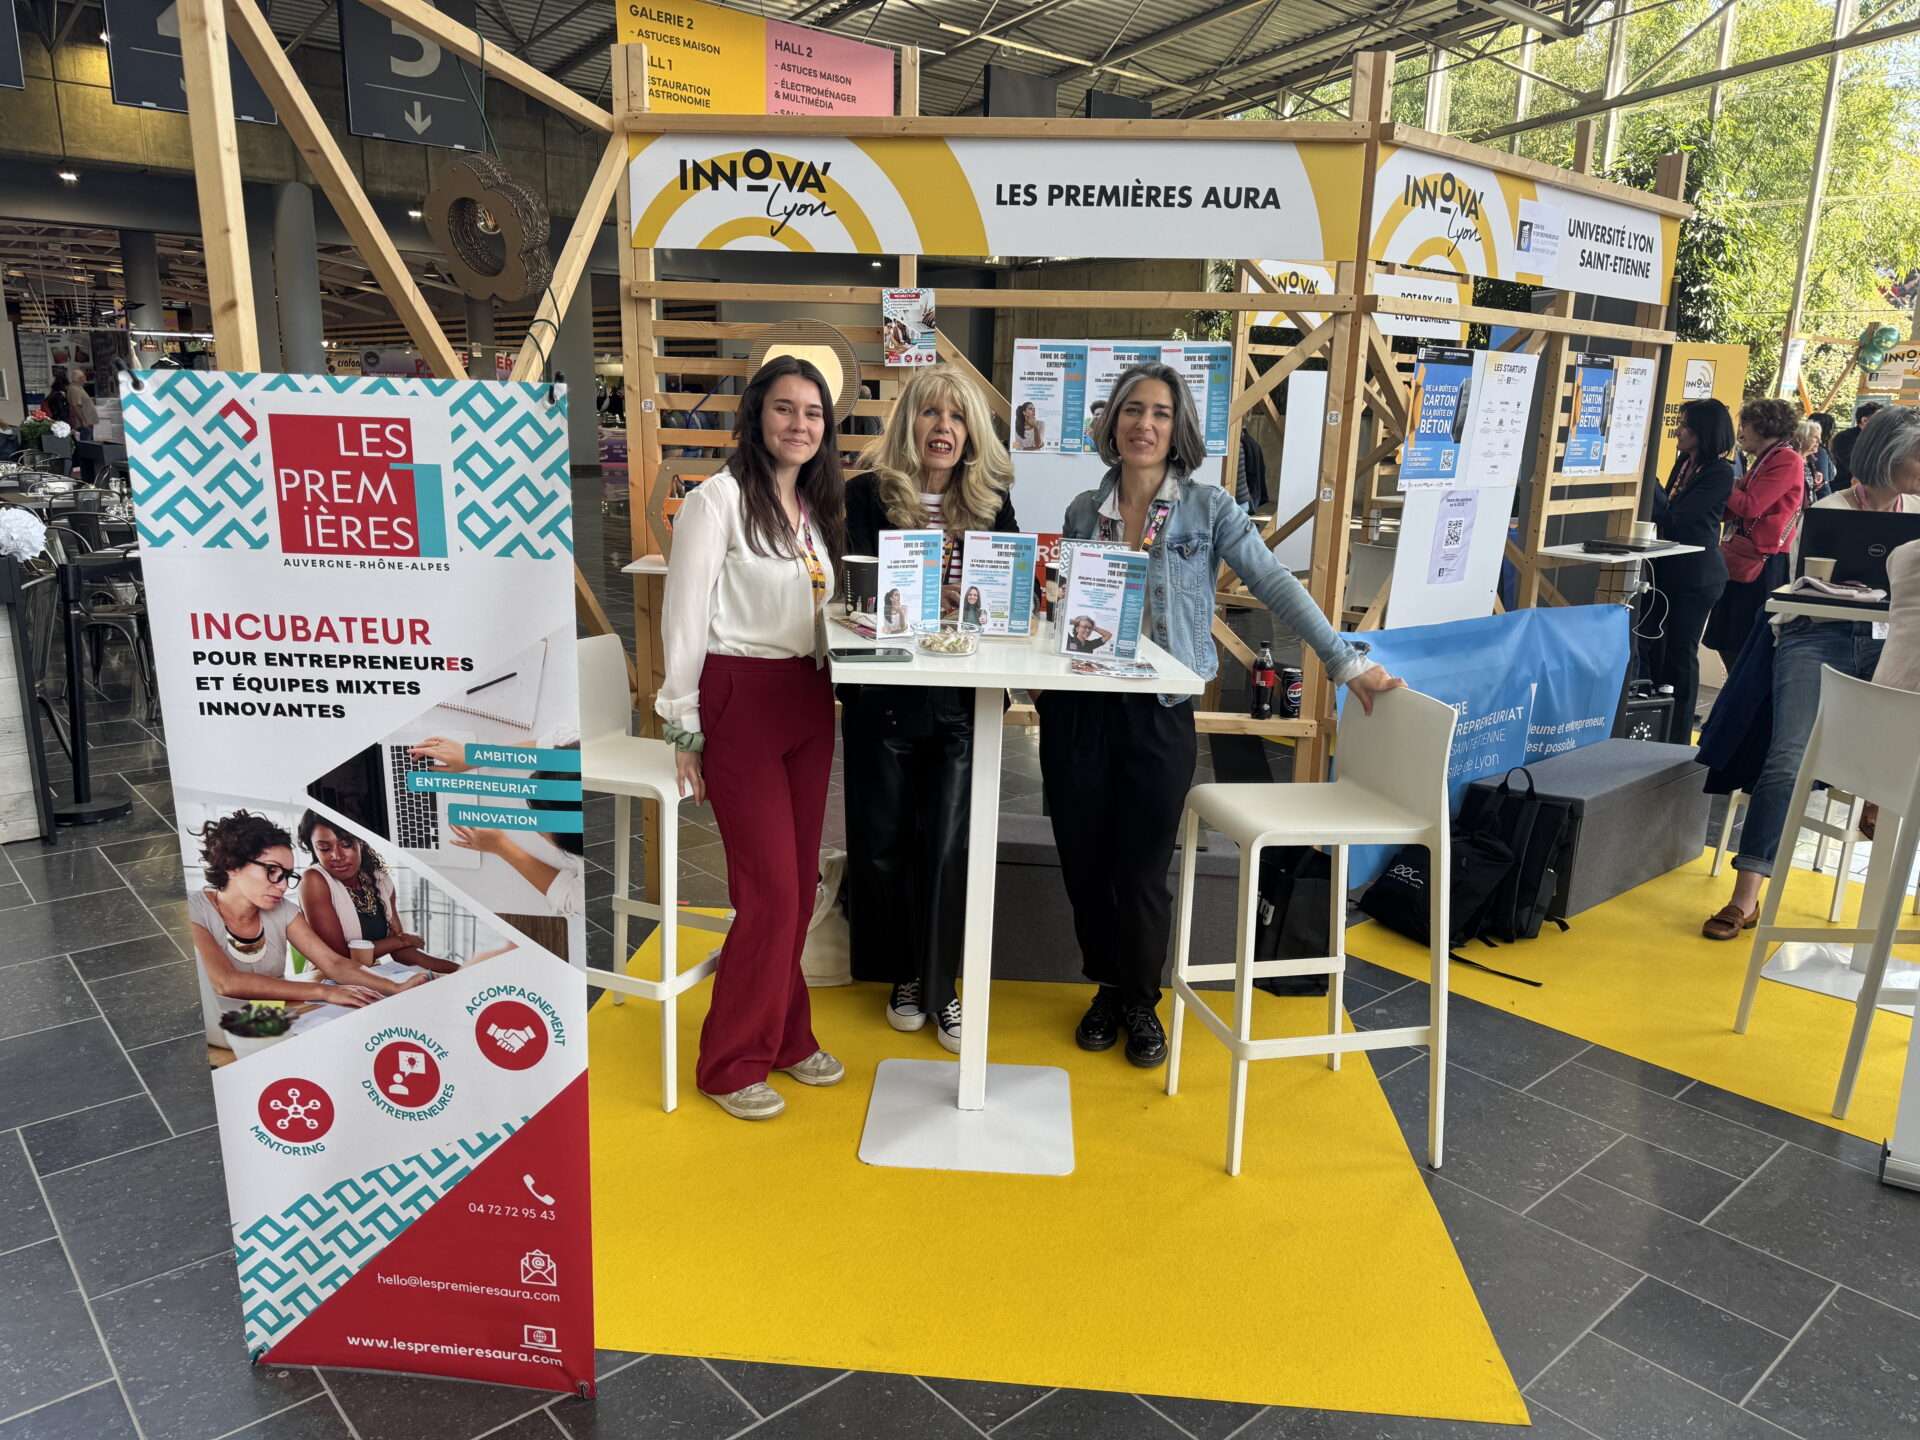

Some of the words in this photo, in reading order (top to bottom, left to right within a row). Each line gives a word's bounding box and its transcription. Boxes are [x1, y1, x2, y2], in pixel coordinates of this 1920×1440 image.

[629, 4, 684, 28] GALERIE
[686, 17, 694, 30] 2
[637, 28, 680, 47] ASTUCES
[683, 37, 721, 56] MAISON
[774, 39, 804, 57] HALL
[805, 46, 813, 58] 2
[667, 59, 673, 71] 1
[780, 61, 818, 79] ASTUCES
[819, 71, 852, 87] MAISON
[647, 75, 711, 97] ESTAURATION
[780, 78, 857, 104] ÉLECTROMÉNAGER
[648, 89, 711, 109] ASTRONOMIE
[774, 90, 781, 99] &
[782, 90, 834, 111] MULTIMÉDIA
[996, 183, 1037, 206] LES
[1047, 178, 1193, 208] PREMIÈRES
[1201, 186, 1281, 210] AURA
[766, 184, 837, 237] Lyon
[1447, 207, 1481, 257] Lyon
[1567, 217, 1626, 248] UNIVERSITÉ
[1627, 232, 1654, 254] LYON
[1579, 249, 1651, 279] SAINT-ETIENNE
[1503, 364, 1527, 374] STARTUPS
[1423, 394, 1457, 407] CARTON
[1420, 415, 1451, 434] BÉTON
[337, 422, 407, 458] LES
[279, 468, 398, 505] PREM
[283, 558, 450, 572] AUVERGNE-RHÔNE-ALPES
[190, 612, 432, 645] INCUBATEUR
[192, 651, 257, 666] POUR
[264, 652, 474, 672] ENTREPRENEURES
[195, 676, 225, 691] ET
[232, 673, 330, 694] ÉQUIPES
[336, 679, 421, 695] MIXTES
[198, 701, 346, 719] INNOVANTES
[1557, 722, 1564, 734] et
[474, 750, 538, 765] AMBITION
[1474, 753, 1499, 773] Lyon
[415, 777, 538, 795] ENTREPRENEURIAT
[458, 810, 538, 826] INNOVATION
[465, 984, 566, 1047] ACCOMPAGNEMENT
[364, 1026, 449, 1061] COMMUNAUTÉ
[361, 1079, 455, 1122] D'ENTREPRENEURES
[250, 1125, 326, 1156] MENTORING
[468, 1202, 485, 1214] 04
[486, 1204, 502, 1216] 72
[504, 1206, 519, 1217] 72
[521, 1207, 537, 1219] 95
[540, 1210, 556, 1221] 43
[377, 1272, 561, 1303] hello@lespremieresaura.com
[346, 1335, 563, 1367] www.lespremieresaura.com
